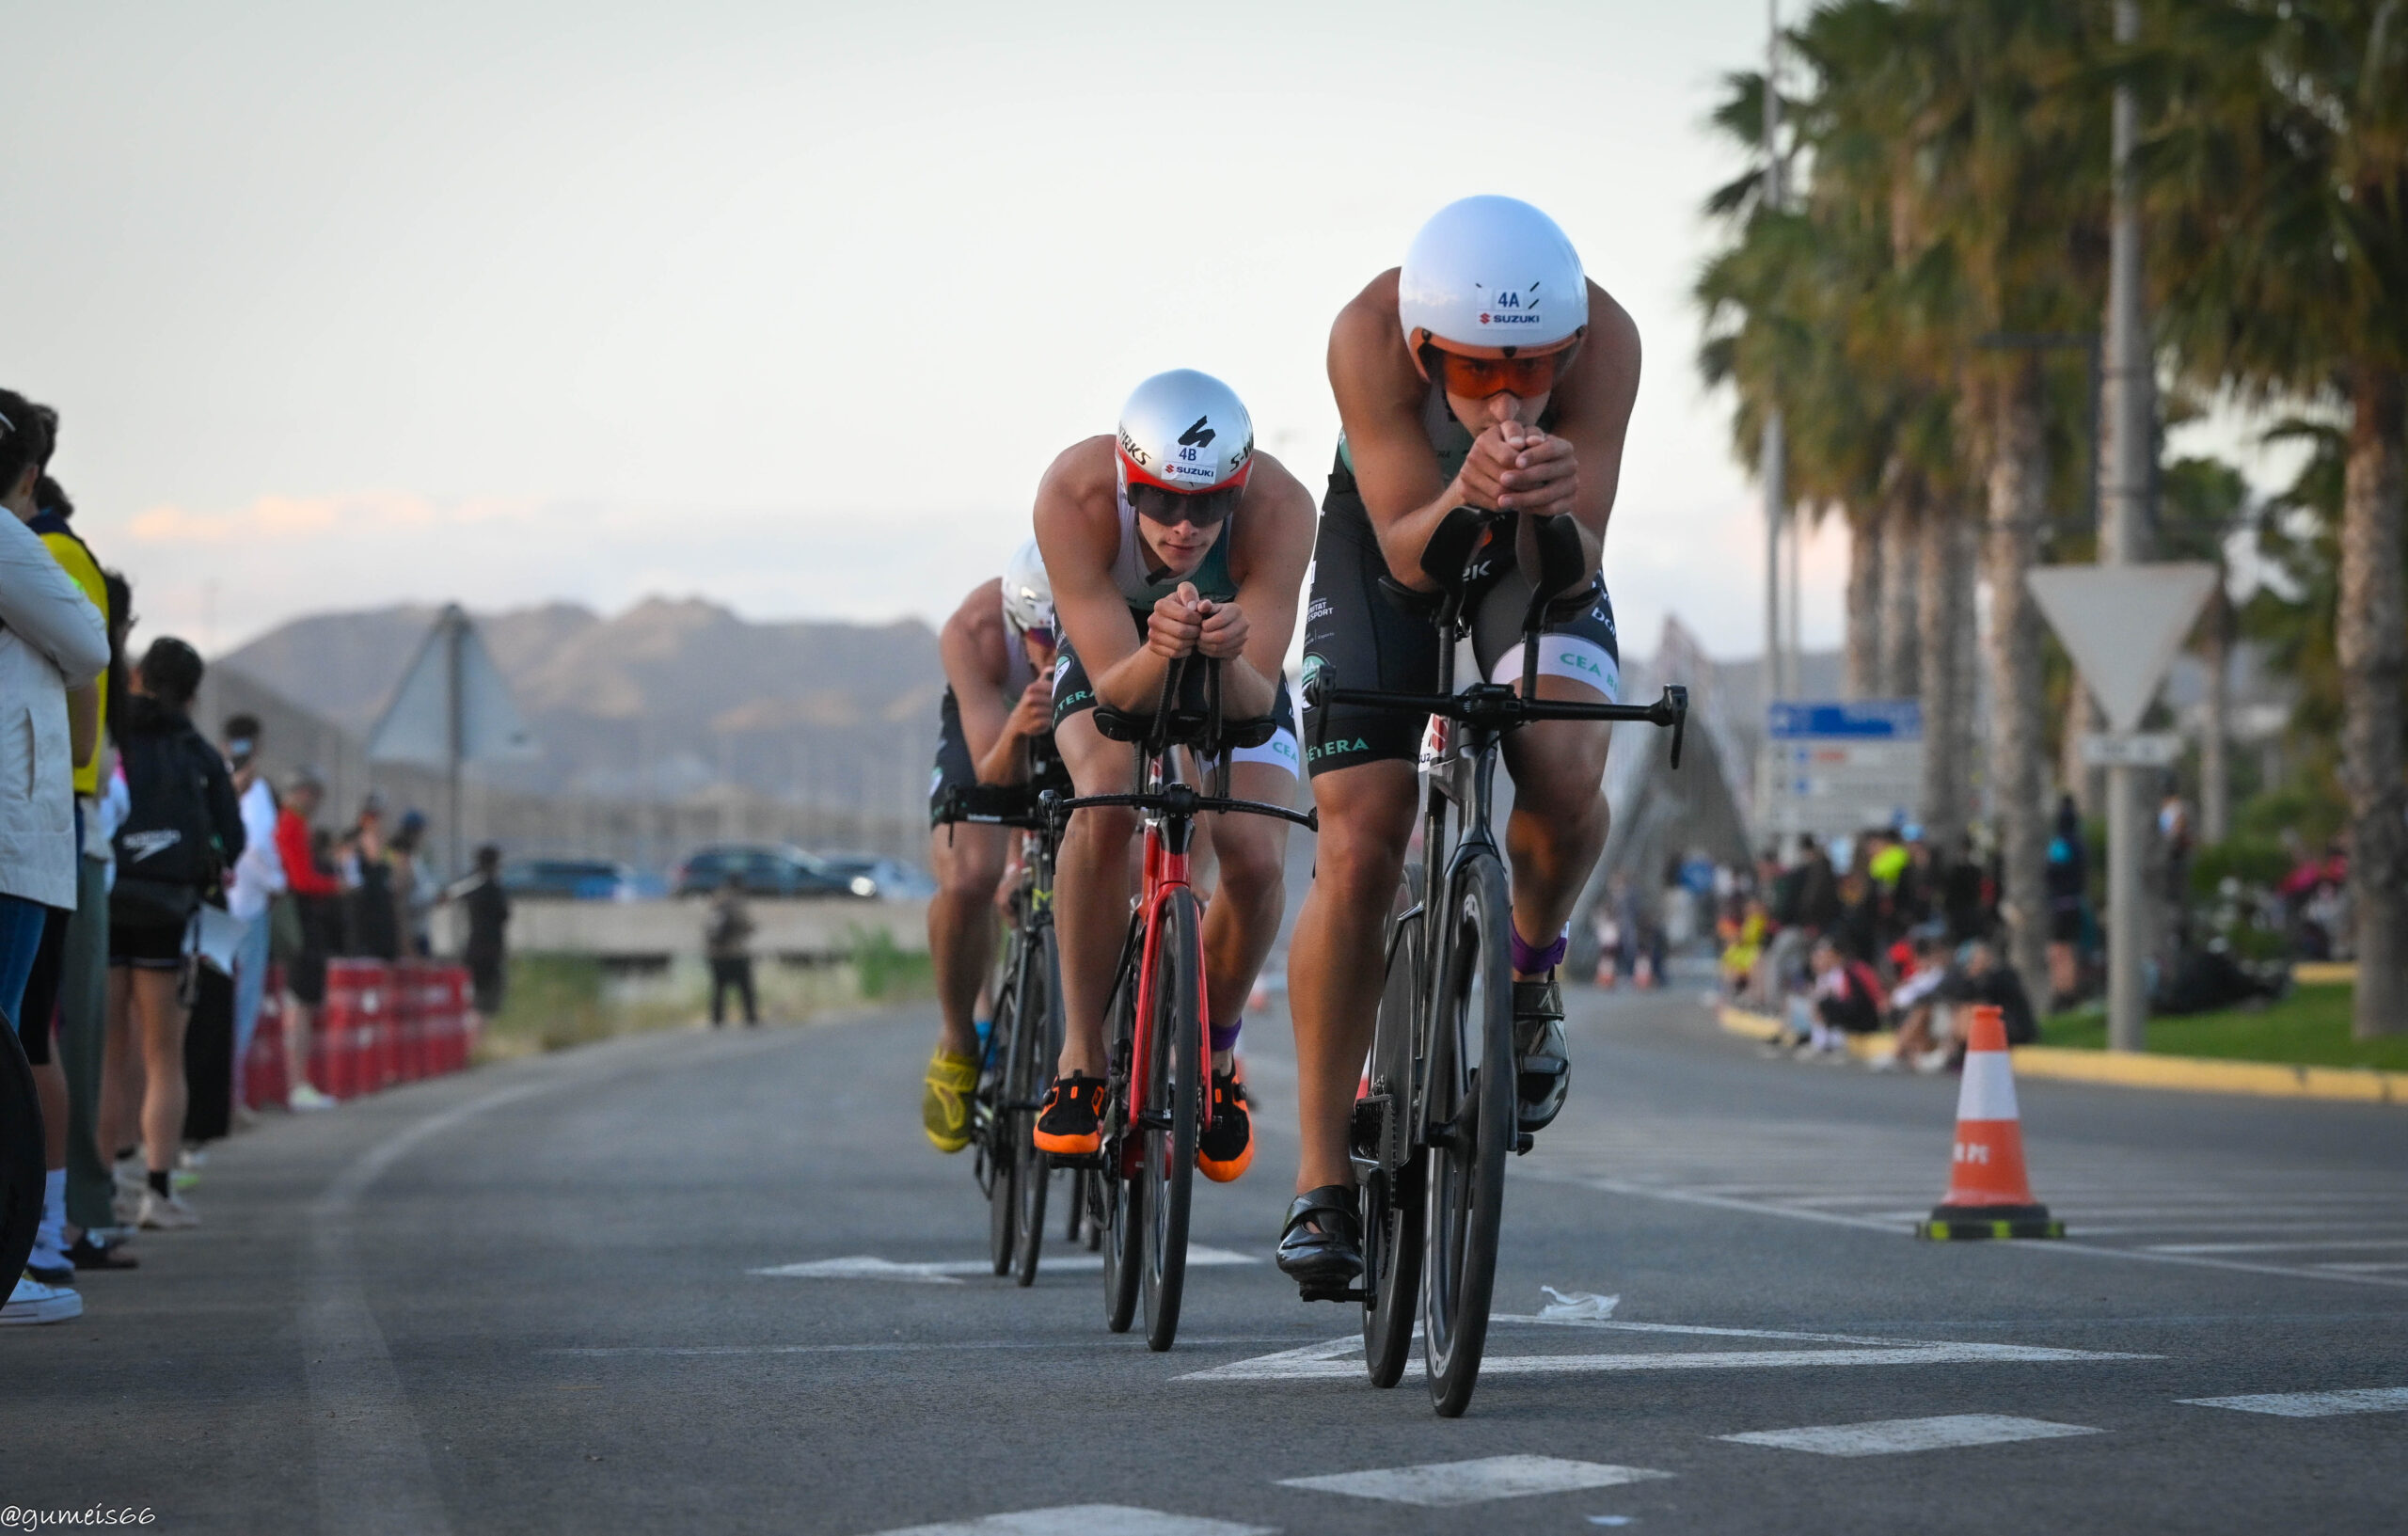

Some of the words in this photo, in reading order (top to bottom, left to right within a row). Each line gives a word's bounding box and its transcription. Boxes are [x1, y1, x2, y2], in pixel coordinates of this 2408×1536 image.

[1497, 291, 1520, 309] 4A
[1493, 313, 1540, 325] SUZUKI
[1179, 447, 1197, 462] 4B
[1176, 466, 1214, 478] SUZUKI
[1307, 607, 1334, 625] ESPORT
[1560, 653, 1602, 678] CEA
[1273, 741, 1298, 764] CEA
